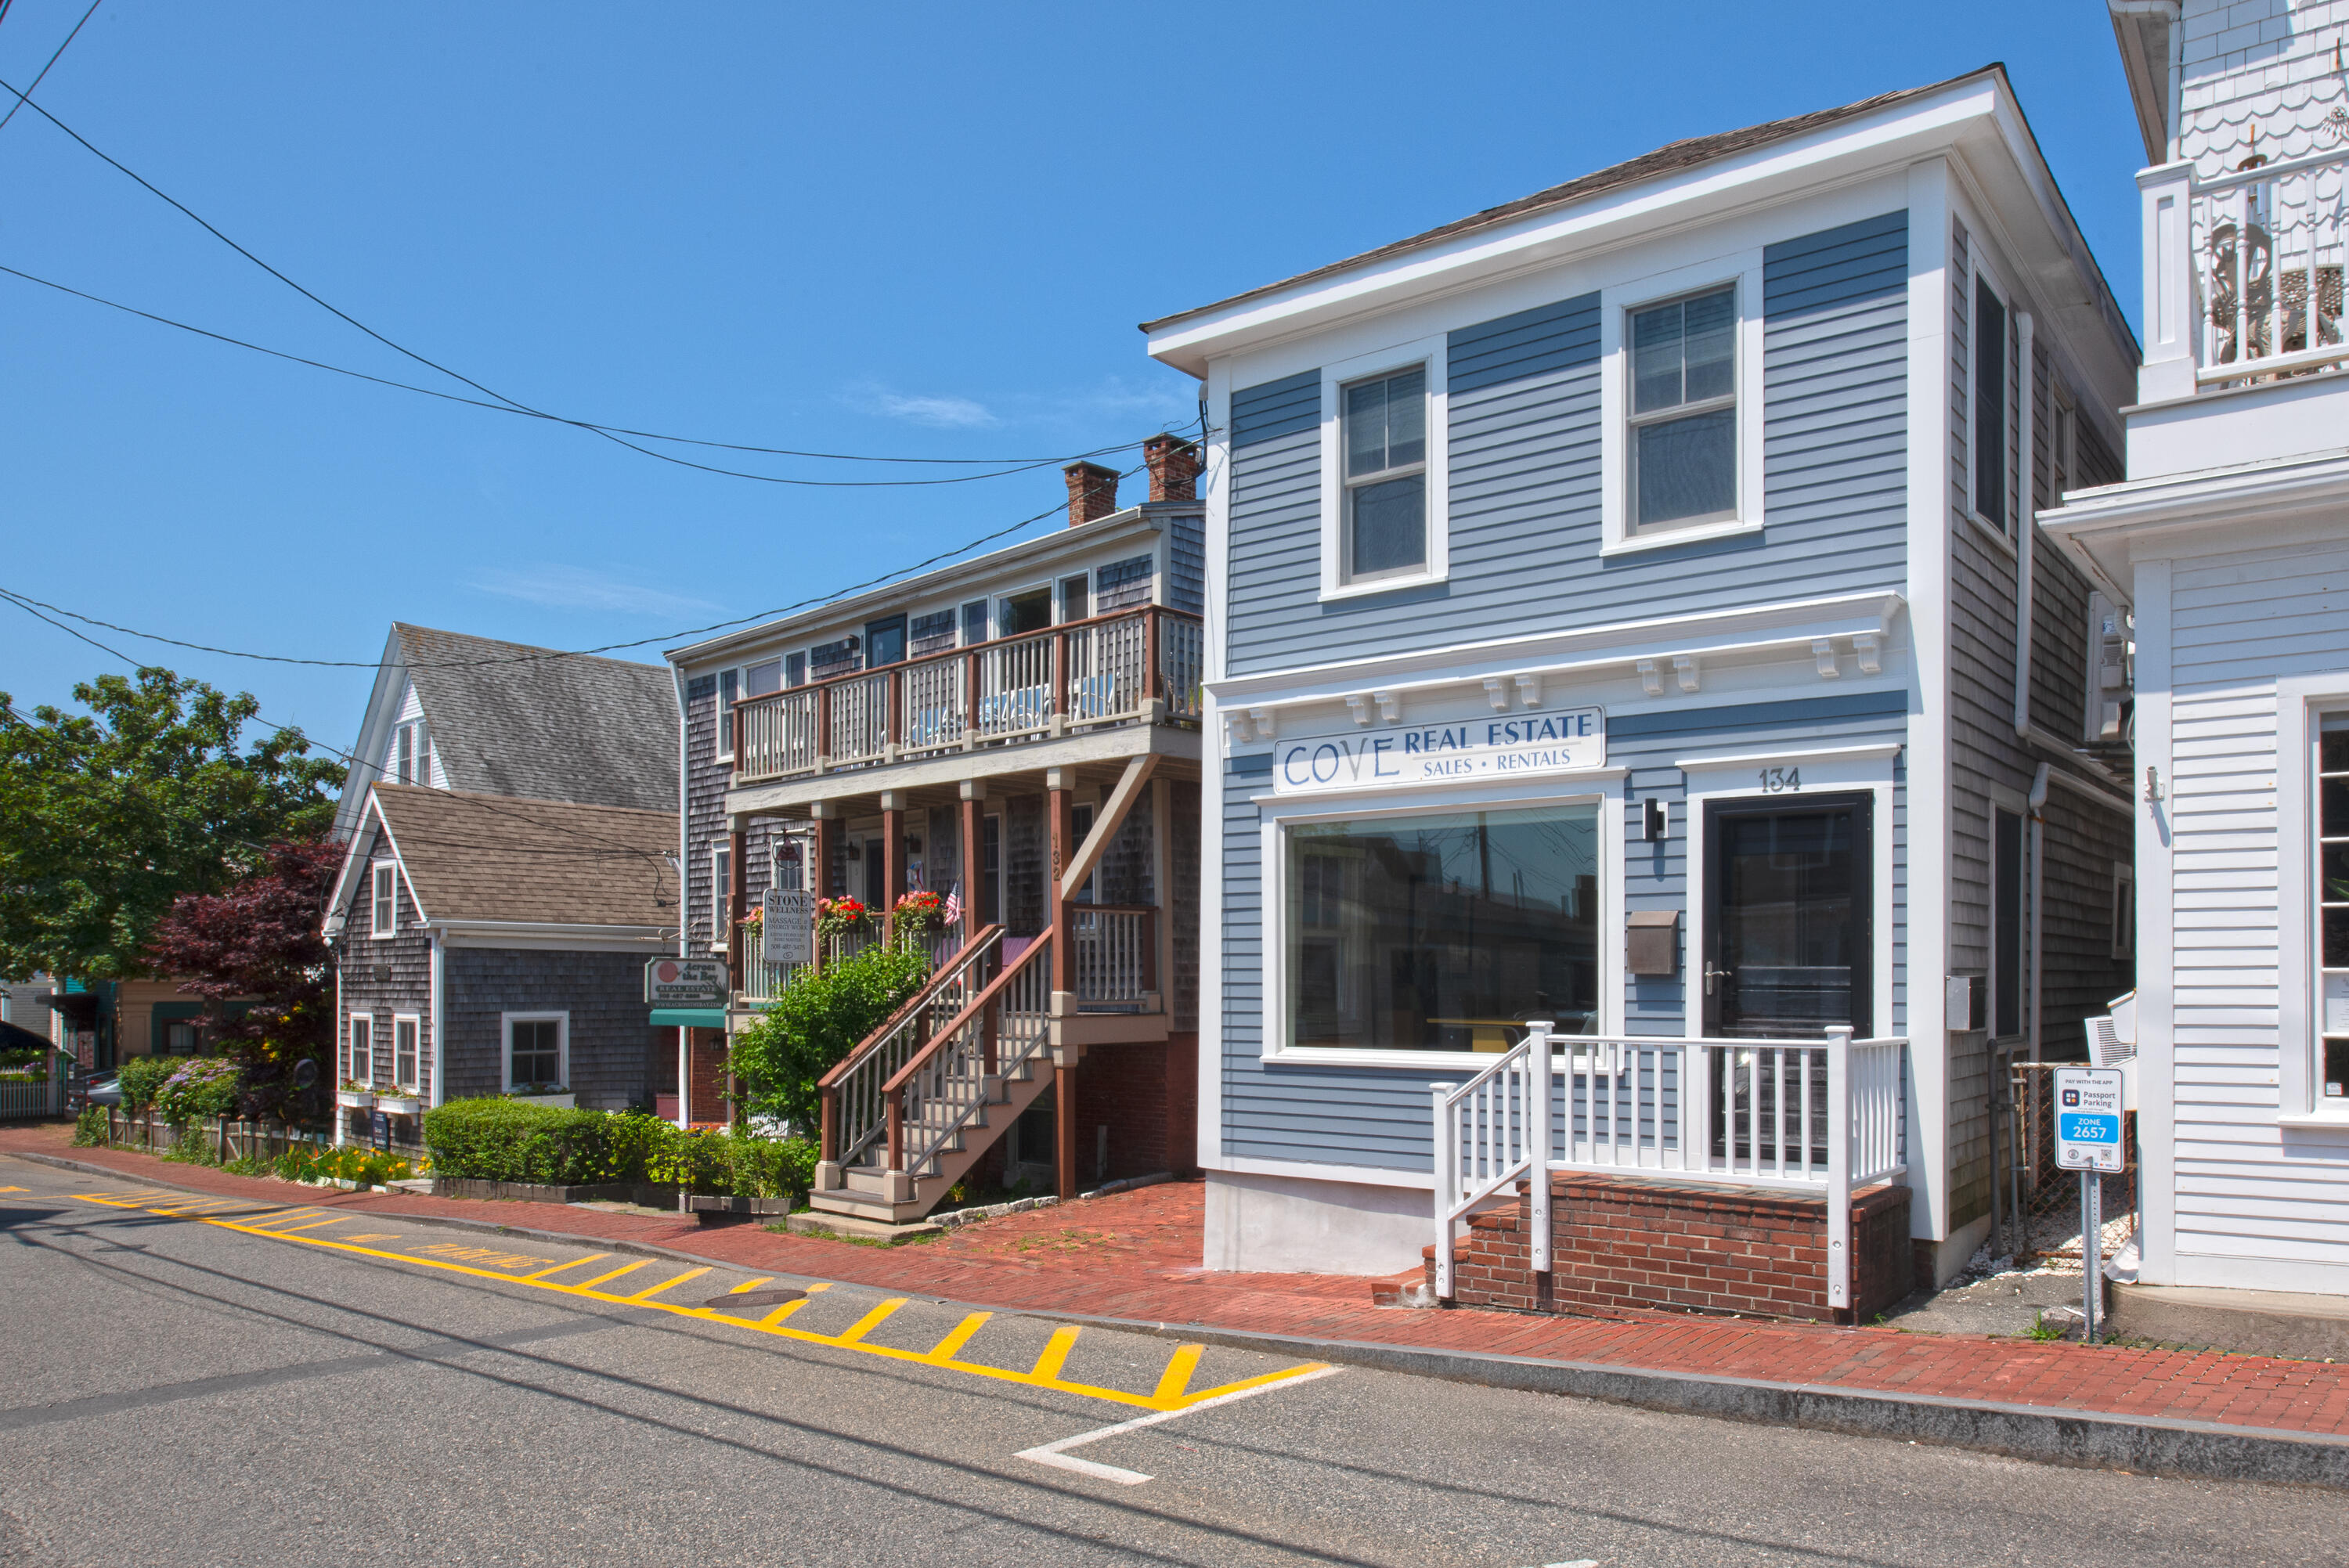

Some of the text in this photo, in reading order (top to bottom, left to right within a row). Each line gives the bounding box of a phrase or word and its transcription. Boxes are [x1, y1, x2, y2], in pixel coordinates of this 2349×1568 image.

[1405, 714, 1592, 754] REAL ESTATE
[1284, 737, 1400, 785] COVE
[1423, 748, 1571, 777] SALES RENTALS
[1759, 767, 1802, 793] 134
[1052, 832, 1061, 881] 132
[768, 895, 808, 907] STONE
[682, 971, 718, 984] the Bay
[684, 962, 716, 971] Across
[2084, 1099, 2112, 1108] Parking
[2073, 1126, 2107, 1139] 2657
[405, 1243, 556, 1268] PARKING
